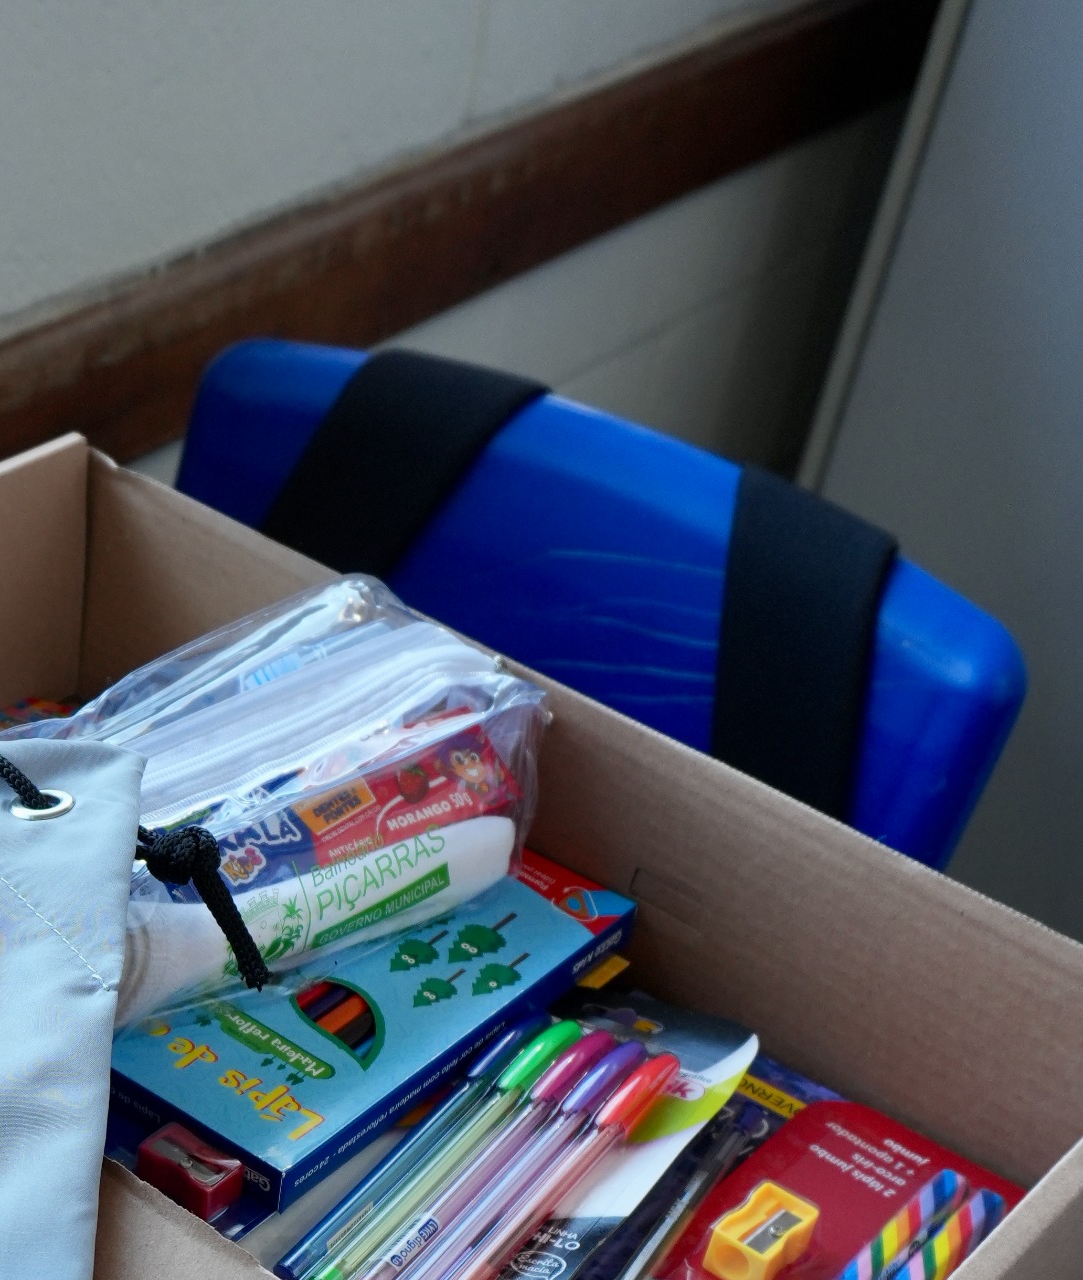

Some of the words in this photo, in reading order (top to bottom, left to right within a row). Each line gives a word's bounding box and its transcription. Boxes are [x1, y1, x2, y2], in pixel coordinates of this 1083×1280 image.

[386, 800, 450, 832] MORANGO
[317, 823, 446, 921] PIÇARRAS
[319, 909, 382, 944] GOVERNO
[385, 873, 445, 915] MUNICIPAL
[168, 1036, 219, 1069] de
[270, 1038, 326, 1077] Madeira
[423, 1071, 440, 1087] com
[218, 1069, 325, 1141] Lápis
[389, 1083, 422, 1114] madeira
[337, 1111, 388, 1154] reflorestada
[825, 1122, 894, 1163] apontador
[809, 1144, 855, 1172] jumbo
[883, 1138, 931, 1167] jumbo
[244, 1166, 271, 1192] Gat
[294, 1164, 319, 1188] cores
[883, 1188, 896, 1198] 2
[533, 1231, 581, 1251] HI-LO
[548, 1226, 578, 1240] LINHA
[517, 1251, 560, 1268] Escrita
[519, 1262, 551, 1274] macia
